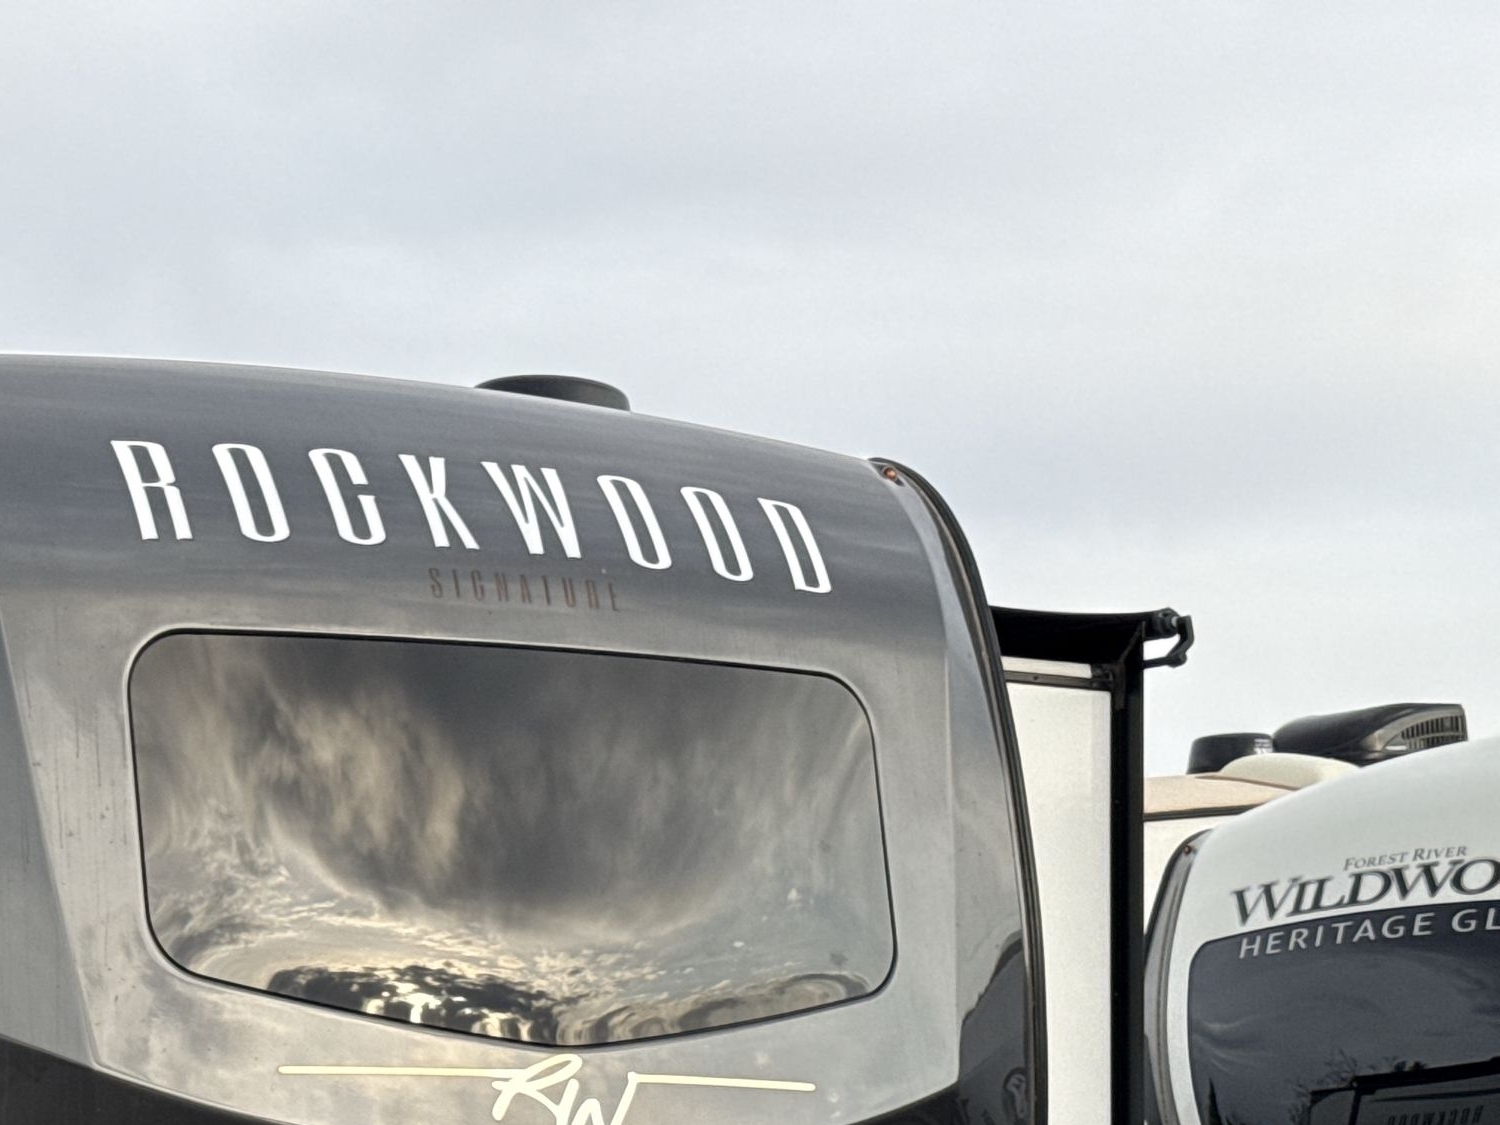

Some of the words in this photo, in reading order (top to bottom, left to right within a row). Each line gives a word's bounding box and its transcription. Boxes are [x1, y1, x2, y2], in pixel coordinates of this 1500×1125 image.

[110, 440, 832, 593] ROCKWOOD
[427, 567, 619, 611] SIGNATURE
[1343, 851, 1409, 871] FOREST
[1413, 846, 1467, 861] RIVER
[1239, 911, 1436, 959] HERITAGE
